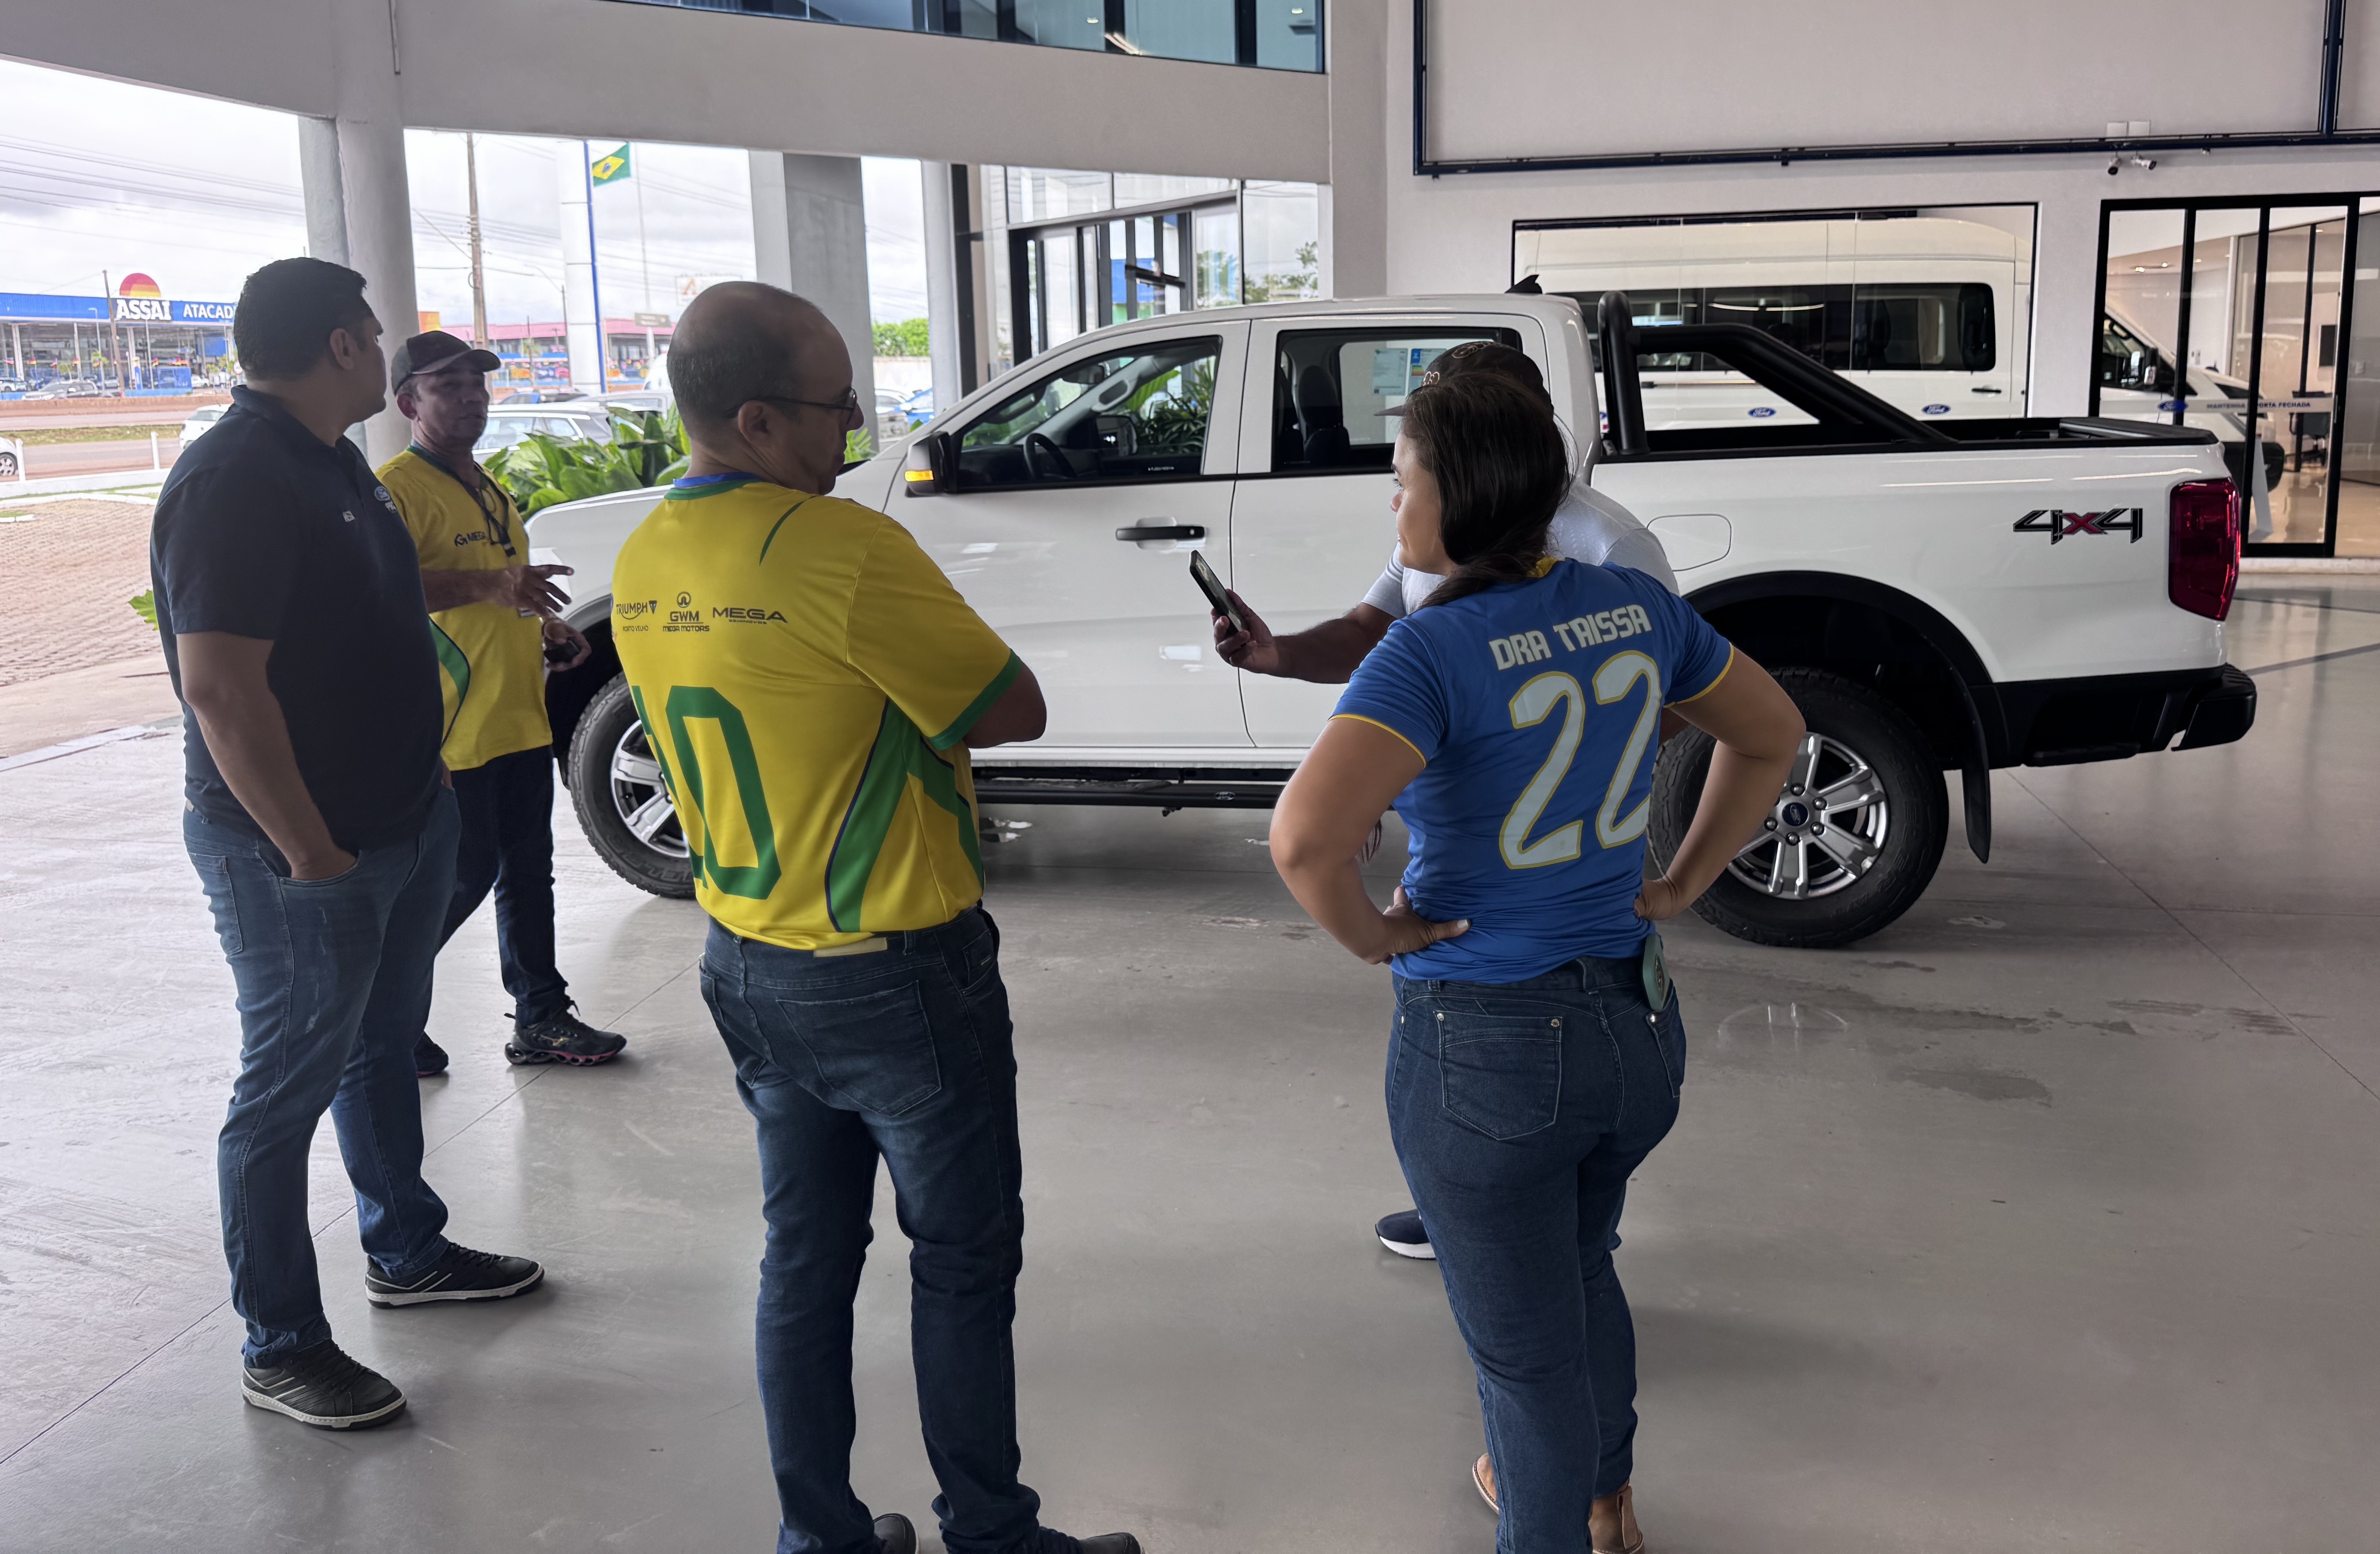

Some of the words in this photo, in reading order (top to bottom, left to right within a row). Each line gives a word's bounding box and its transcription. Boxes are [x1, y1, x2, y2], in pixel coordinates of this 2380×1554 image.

[183, 304, 235, 319] ATACAD
[616, 602, 647, 620] TRIUMPH
[670, 611, 699, 622] GWM
[713, 607, 788, 623] MEGA
[1489, 630, 1552, 671] DRA
[1553, 604, 1652, 651] TAISSA
[1499, 650, 1661, 869] 22
[631, 685, 782, 900] 0
